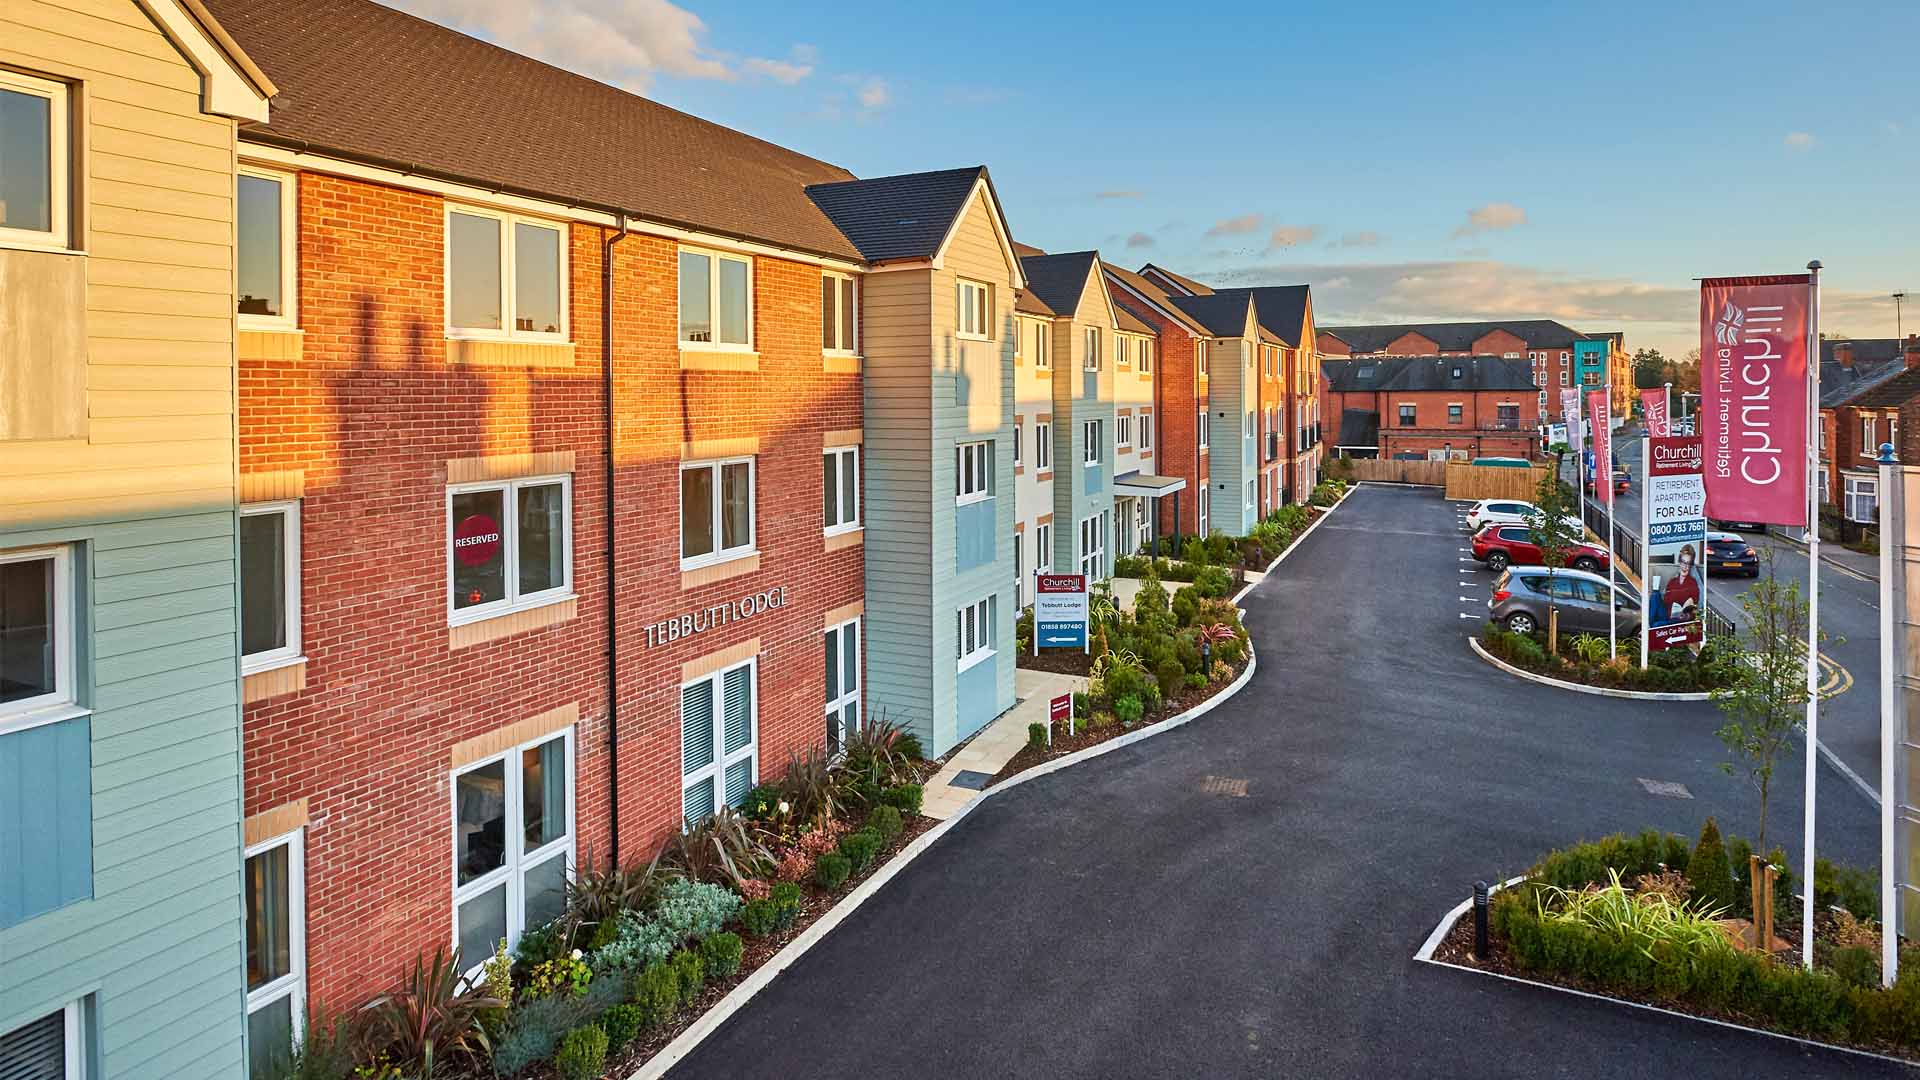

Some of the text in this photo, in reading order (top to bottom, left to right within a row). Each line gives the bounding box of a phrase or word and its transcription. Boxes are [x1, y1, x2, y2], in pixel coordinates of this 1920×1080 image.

[1654, 443, 1702, 460] Churchill
[1655, 480, 1700, 490] RETIREMENT
[1654, 492, 1701, 503] APARTMENTS
[1656, 505, 1700, 518] FOR SALE
[1651, 521, 1704, 535] 0800 783 7661
[455, 533, 499, 548] RESERVED
[1042, 578, 1080, 586] Churchill
[643, 585, 788, 649] TEBBUTT LODGE
